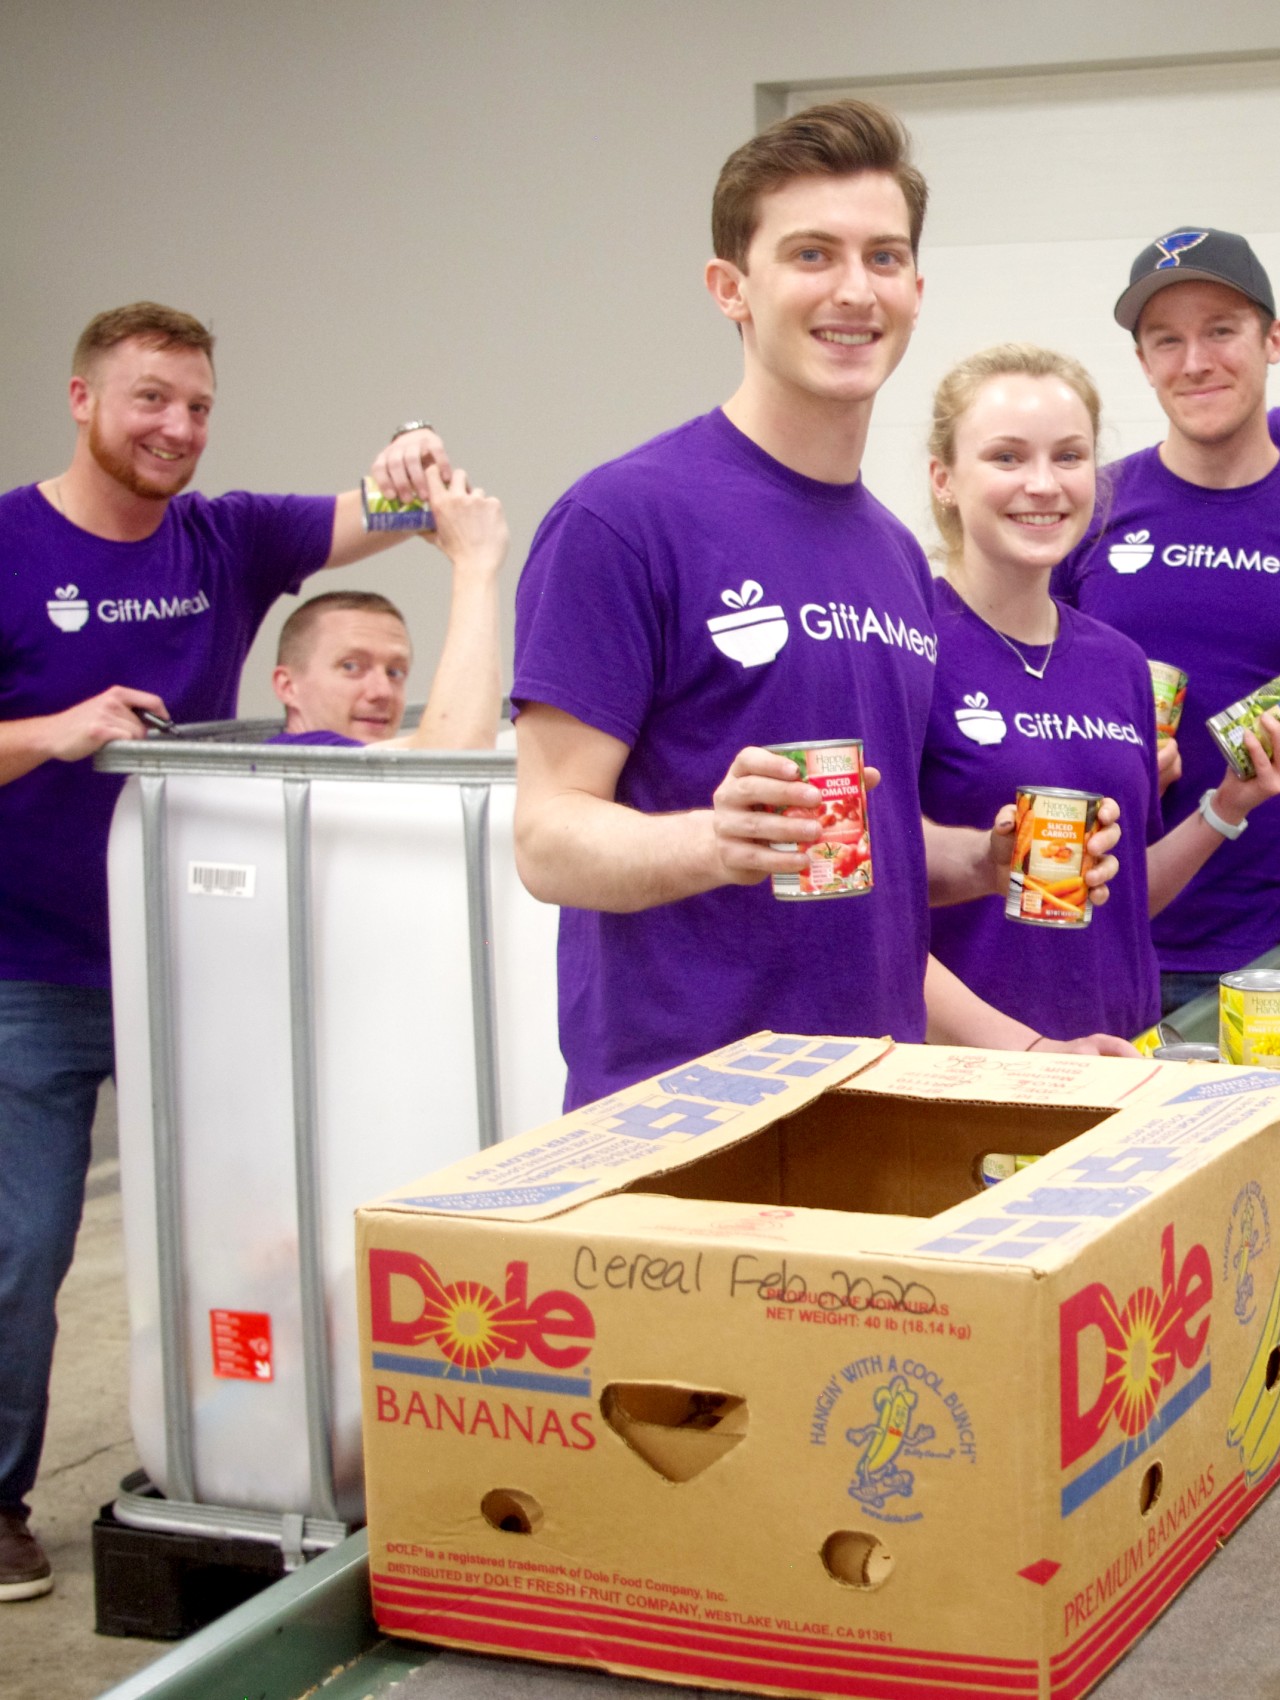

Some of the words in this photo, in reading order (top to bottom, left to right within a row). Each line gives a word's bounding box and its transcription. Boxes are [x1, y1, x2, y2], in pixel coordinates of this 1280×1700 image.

[97, 589, 210, 624] GiftAMeal
[800, 602, 938, 665] GiftAMea
[821, 786, 859, 797] OMATOES
[825, 777, 851, 787] DICED
[1041, 829, 1077, 840] CARROTS
[1047, 822, 1073, 831] SLICED
[369, 1248, 596, 1369] Dole
[574, 1246, 703, 1294] Cereal
[730, 1254, 807, 1303] Feb
[817, 1269, 936, 1315] 2020
[766, 1287, 836, 1306] PRODUCT
[842, 1295, 861, 1307] OF
[864, 1297, 950, 1317] HONDURAS
[766, 1306, 795, 1321] NET
[799, 1310, 860, 1328] WEIGHT:
[864, 1316, 881, 1329] 40
[885, 1316, 898, 1331] lb
[902, 1318, 945, 1334] (18.14
[949, 1323, 972, 1341] kg)
[1059, 1221, 1213, 1471] Dole
[376, 1385, 597, 1452] BANANAS
[810, 1375, 843, 1446] HANGIN'
[840, 1355, 883, 1384] WITH
[888, 1354, 898, 1373] A
[902, 1358, 944, 1397] COOL
[425, 1547, 435, 1559] is
[438, 1552, 445, 1561] a
[448, 1551, 505, 1569] registered
[508, 1558, 567, 1577] trademark
[569, 1567, 581, 1579] of
[584, 1569, 610, 1584] Dole
[613, 1571, 642, 1588] Food
[645, 1578, 701, 1600] Company,
[706, 1585, 728, 1602] Inc.
[1064, 1538, 1144, 1638] PREMIUM
[1147, 1463, 1215, 1559] BANANAS
[387, 1562, 463, 1583] DISTRIBUTED
[465, 1572, 481, 1584] BY
[484, 1572, 523, 1590] DOLE
[527, 1578, 576, 1597] FRESH
[580, 1586, 622, 1604] FRUIT
[626, 1592, 701, 1617] COMPANY,
[704, 1608, 772, 1628] WESTLAKE
[774, 1617, 834, 1637] VILLAGE,
[837, 1626, 854, 1639] CA
[858, 1627, 893, 1643] 91361
